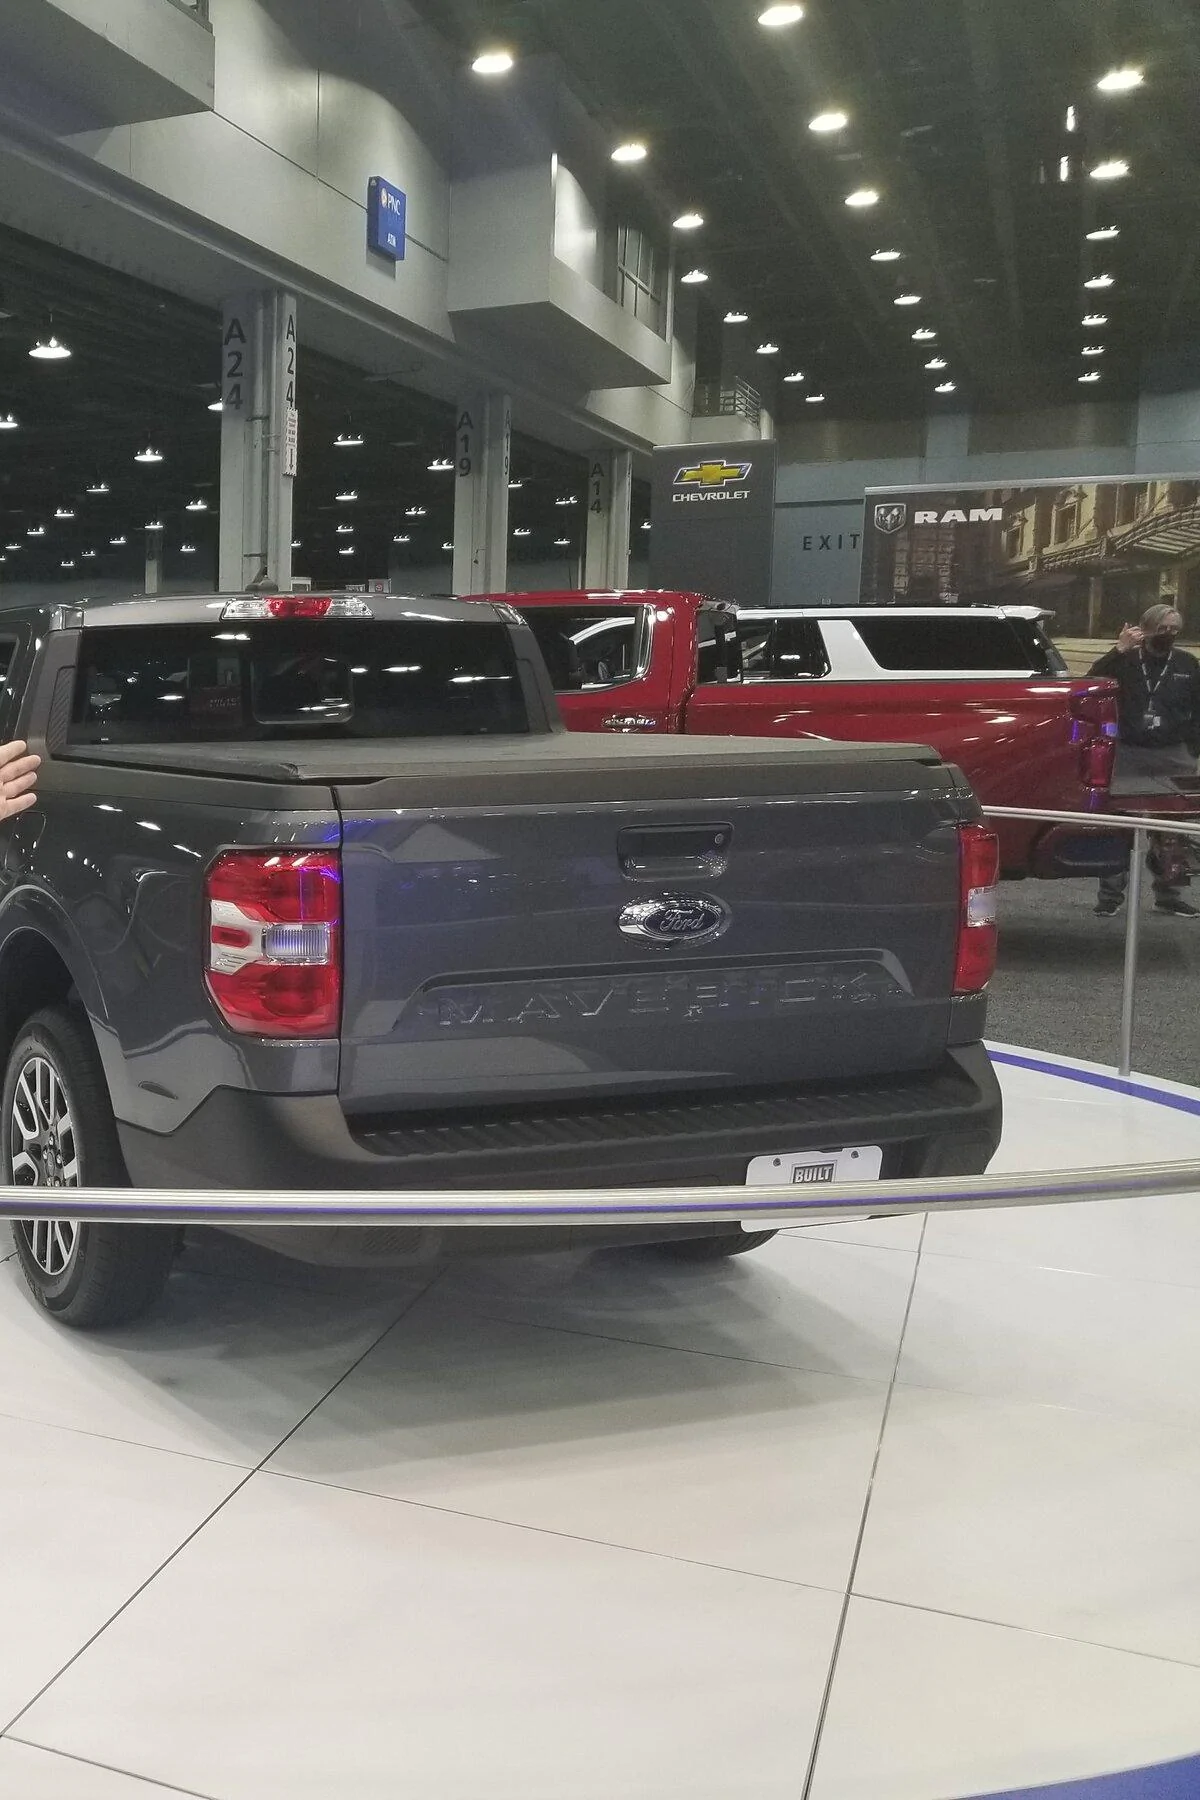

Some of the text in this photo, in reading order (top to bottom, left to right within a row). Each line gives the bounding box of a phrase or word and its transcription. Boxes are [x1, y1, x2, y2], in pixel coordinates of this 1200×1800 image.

[387, 192, 401, 216] PNC
[224, 318, 247, 410] A24
[457, 411, 474, 477] A19
[590, 462, 605, 514] A14
[672, 490, 750, 502] CHEVROLET
[914, 507, 1003, 524] RAM
[802, 533, 861, 551] EXIT
[660, 909, 705, 931] Ford
[436, 971, 882, 1025] MAVERICK
[795, 1165, 833, 1183] BUILT
